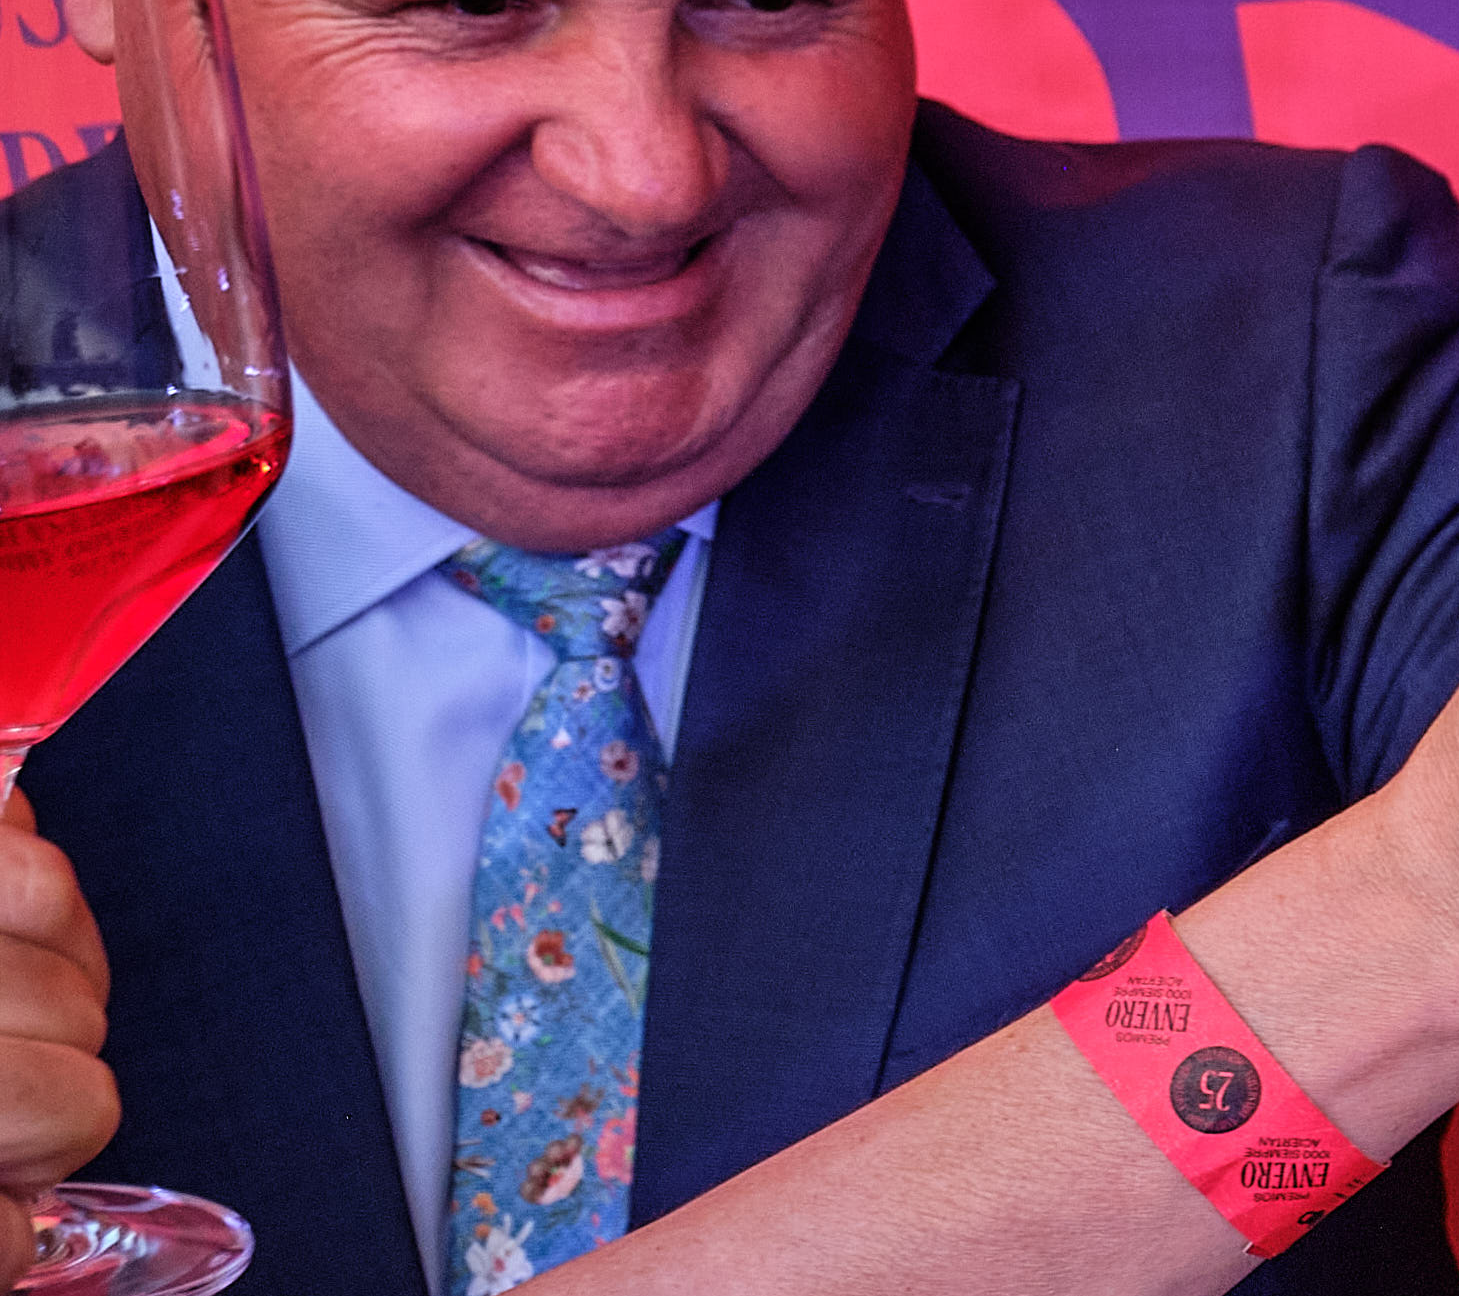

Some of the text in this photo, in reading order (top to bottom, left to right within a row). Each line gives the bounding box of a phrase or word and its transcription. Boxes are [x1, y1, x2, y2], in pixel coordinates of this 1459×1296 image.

[1127, 977, 1182, 986] ACIERTAN
[1113, 988, 1191, 999] 1000 SIEMPRE
[1106, 1001, 1190, 1032] ENVERO
[1116, 1033, 1171, 1045] PREMIOS
[1199, 1070, 1235, 1112] 25
[1258, 1137, 1321, 1149] ACIERTAN
[1243, 1147, 1301, 1159] SIEMPRE
[1241, 1161, 1330, 1189] ENVERO
[1253, 1191, 1311, 1203] PREMIOS
